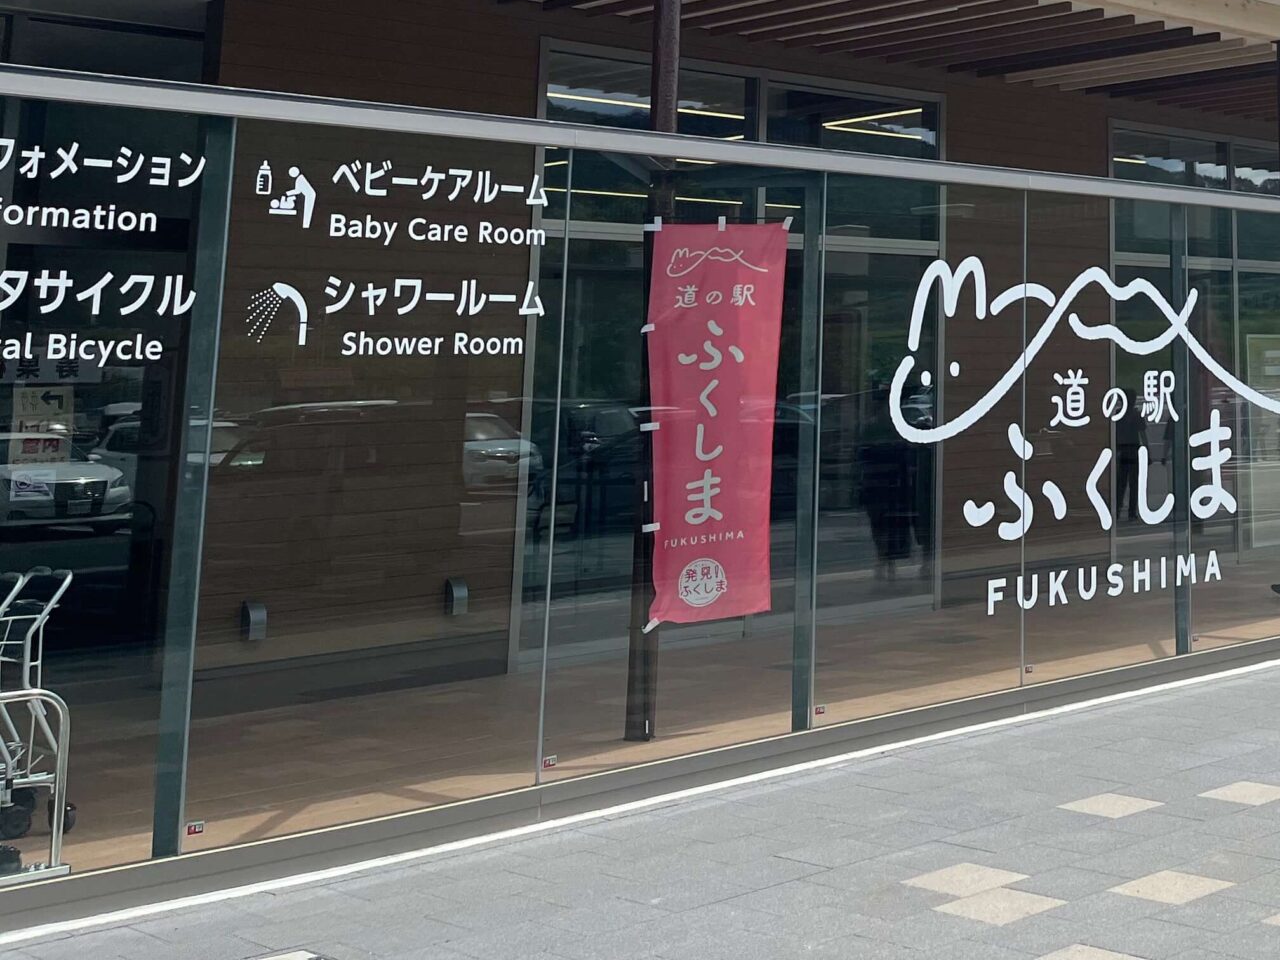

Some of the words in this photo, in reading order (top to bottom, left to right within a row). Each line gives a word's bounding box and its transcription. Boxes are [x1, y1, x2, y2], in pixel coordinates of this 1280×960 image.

[332, 159, 548, 208] ベビーケアルーム
[0, 197, 157, 232] ormation
[329, 218, 397, 246] Baby
[408, 219, 469, 243] Care
[478, 222, 547, 246] Room
[0, 269, 197, 316] タサイクル
[324, 275, 545, 317] シャワールーム
[674, 283, 756, 309] 道の駅
[47, 333, 163, 367] Bicycle
[341, 331, 444, 357] Shower
[453, 331, 525, 356] Room
[1050, 369, 1180, 426] 道の駅
[677, 319, 745, 525] ふくしま
[963, 409, 1237, 540] ふくしま
[664, 530, 745, 550] FUKUSHIMA
[987, 550, 1222, 616] FUKUSHIMA
